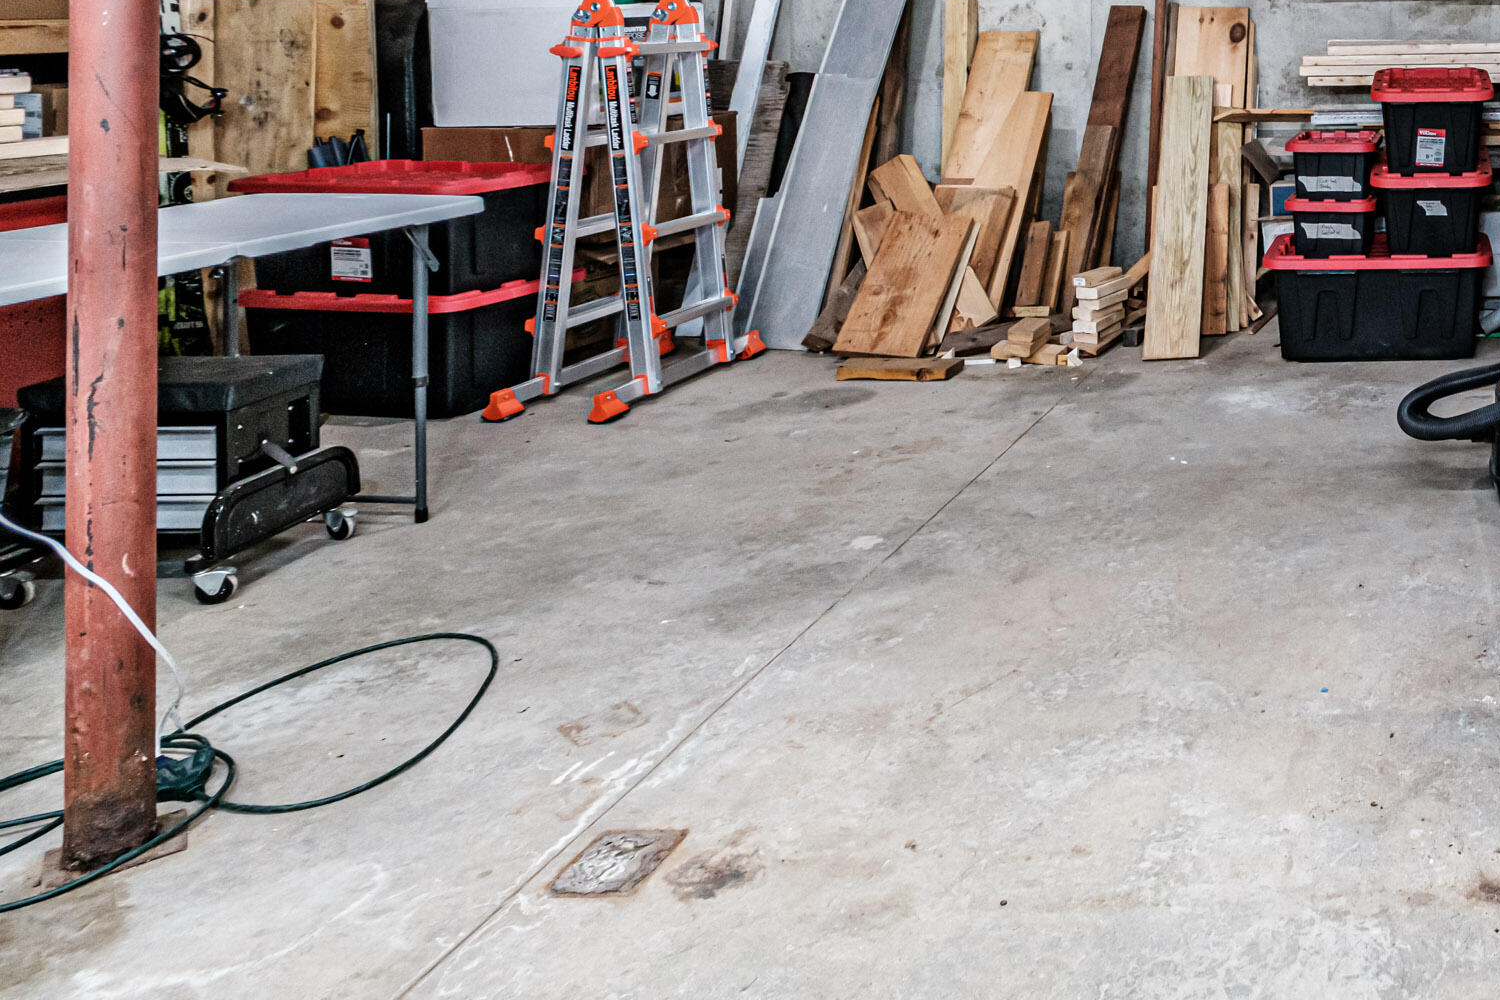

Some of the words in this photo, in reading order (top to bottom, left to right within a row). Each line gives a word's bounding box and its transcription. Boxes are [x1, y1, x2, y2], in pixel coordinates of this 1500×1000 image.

[566, 66, 581, 100] Lanbitou
[605, 65, 617, 100] Lanbitou
[611, 128, 621, 150] Ladder
[561, 128, 573, 150] Ladder
